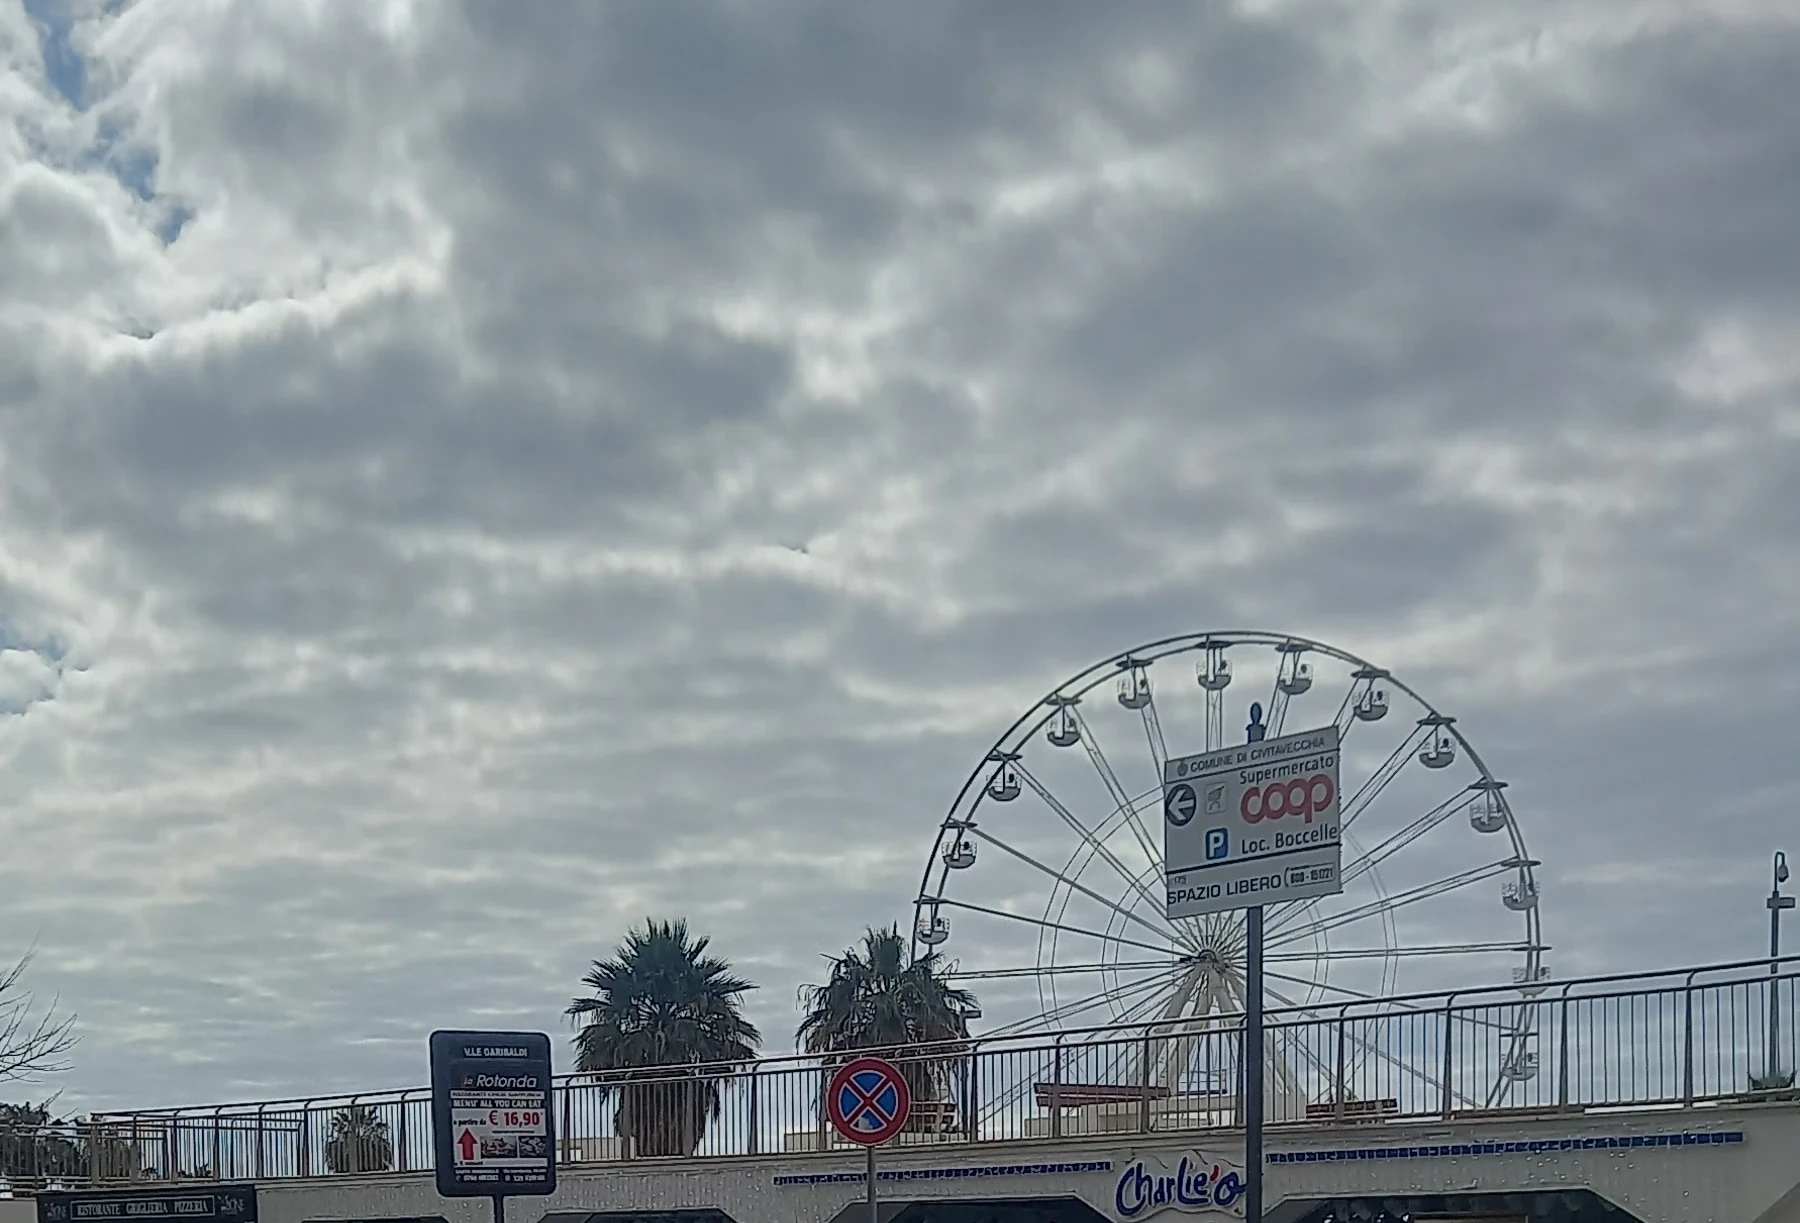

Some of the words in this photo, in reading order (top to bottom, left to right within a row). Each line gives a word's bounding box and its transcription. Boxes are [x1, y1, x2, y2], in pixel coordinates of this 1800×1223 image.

[1190, 754, 1233, 773] COMUNE
[1237, 751, 1247, 764] DI
[1251, 737, 1325, 761] CIVITAVECCHIA
[1239, 755, 1334, 786] Supermercato
[1240, 774, 1334, 824] coop
[1241, 837, 1270, 855] Loc.
[1275, 823, 1338, 849] Boccelle
[1168, 884, 1220, 904] SPAZIO
[1226, 875, 1281, 896] LIBERO
[484, 1047, 527, 1057] GARIBALDI
[477, 1074, 537, 1088] Rotonda
[504, 1111, 540, 1128] 16,90
[77, 1203, 121, 1216] RISTORANTE
[174, 1200, 208, 1213] PIZZERIA
